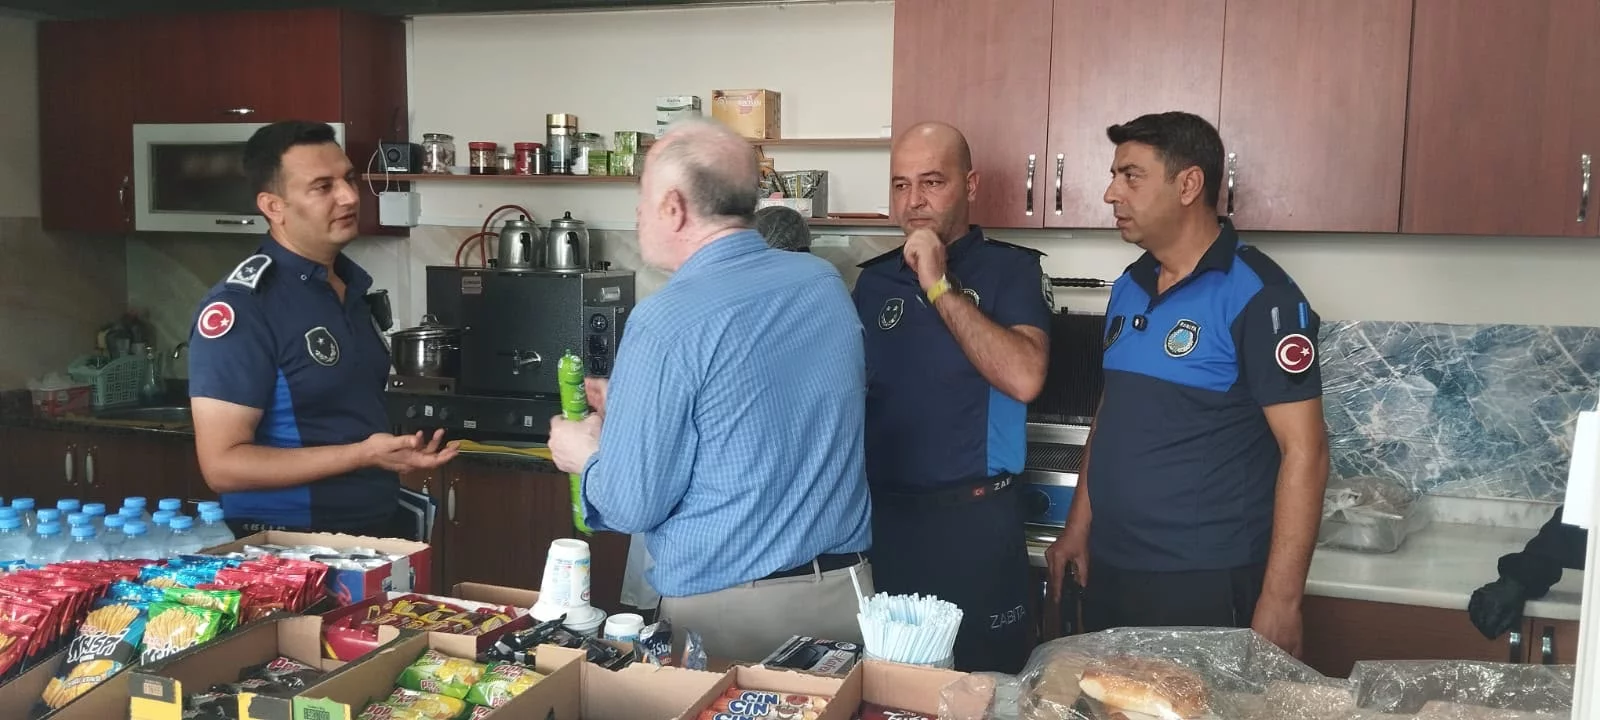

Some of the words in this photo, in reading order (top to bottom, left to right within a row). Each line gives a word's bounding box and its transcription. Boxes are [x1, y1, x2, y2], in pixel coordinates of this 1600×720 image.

[989, 605, 1026, 629] ZABITA
[741, 691, 780, 705] CIN
[728, 699, 770, 716] CIN
